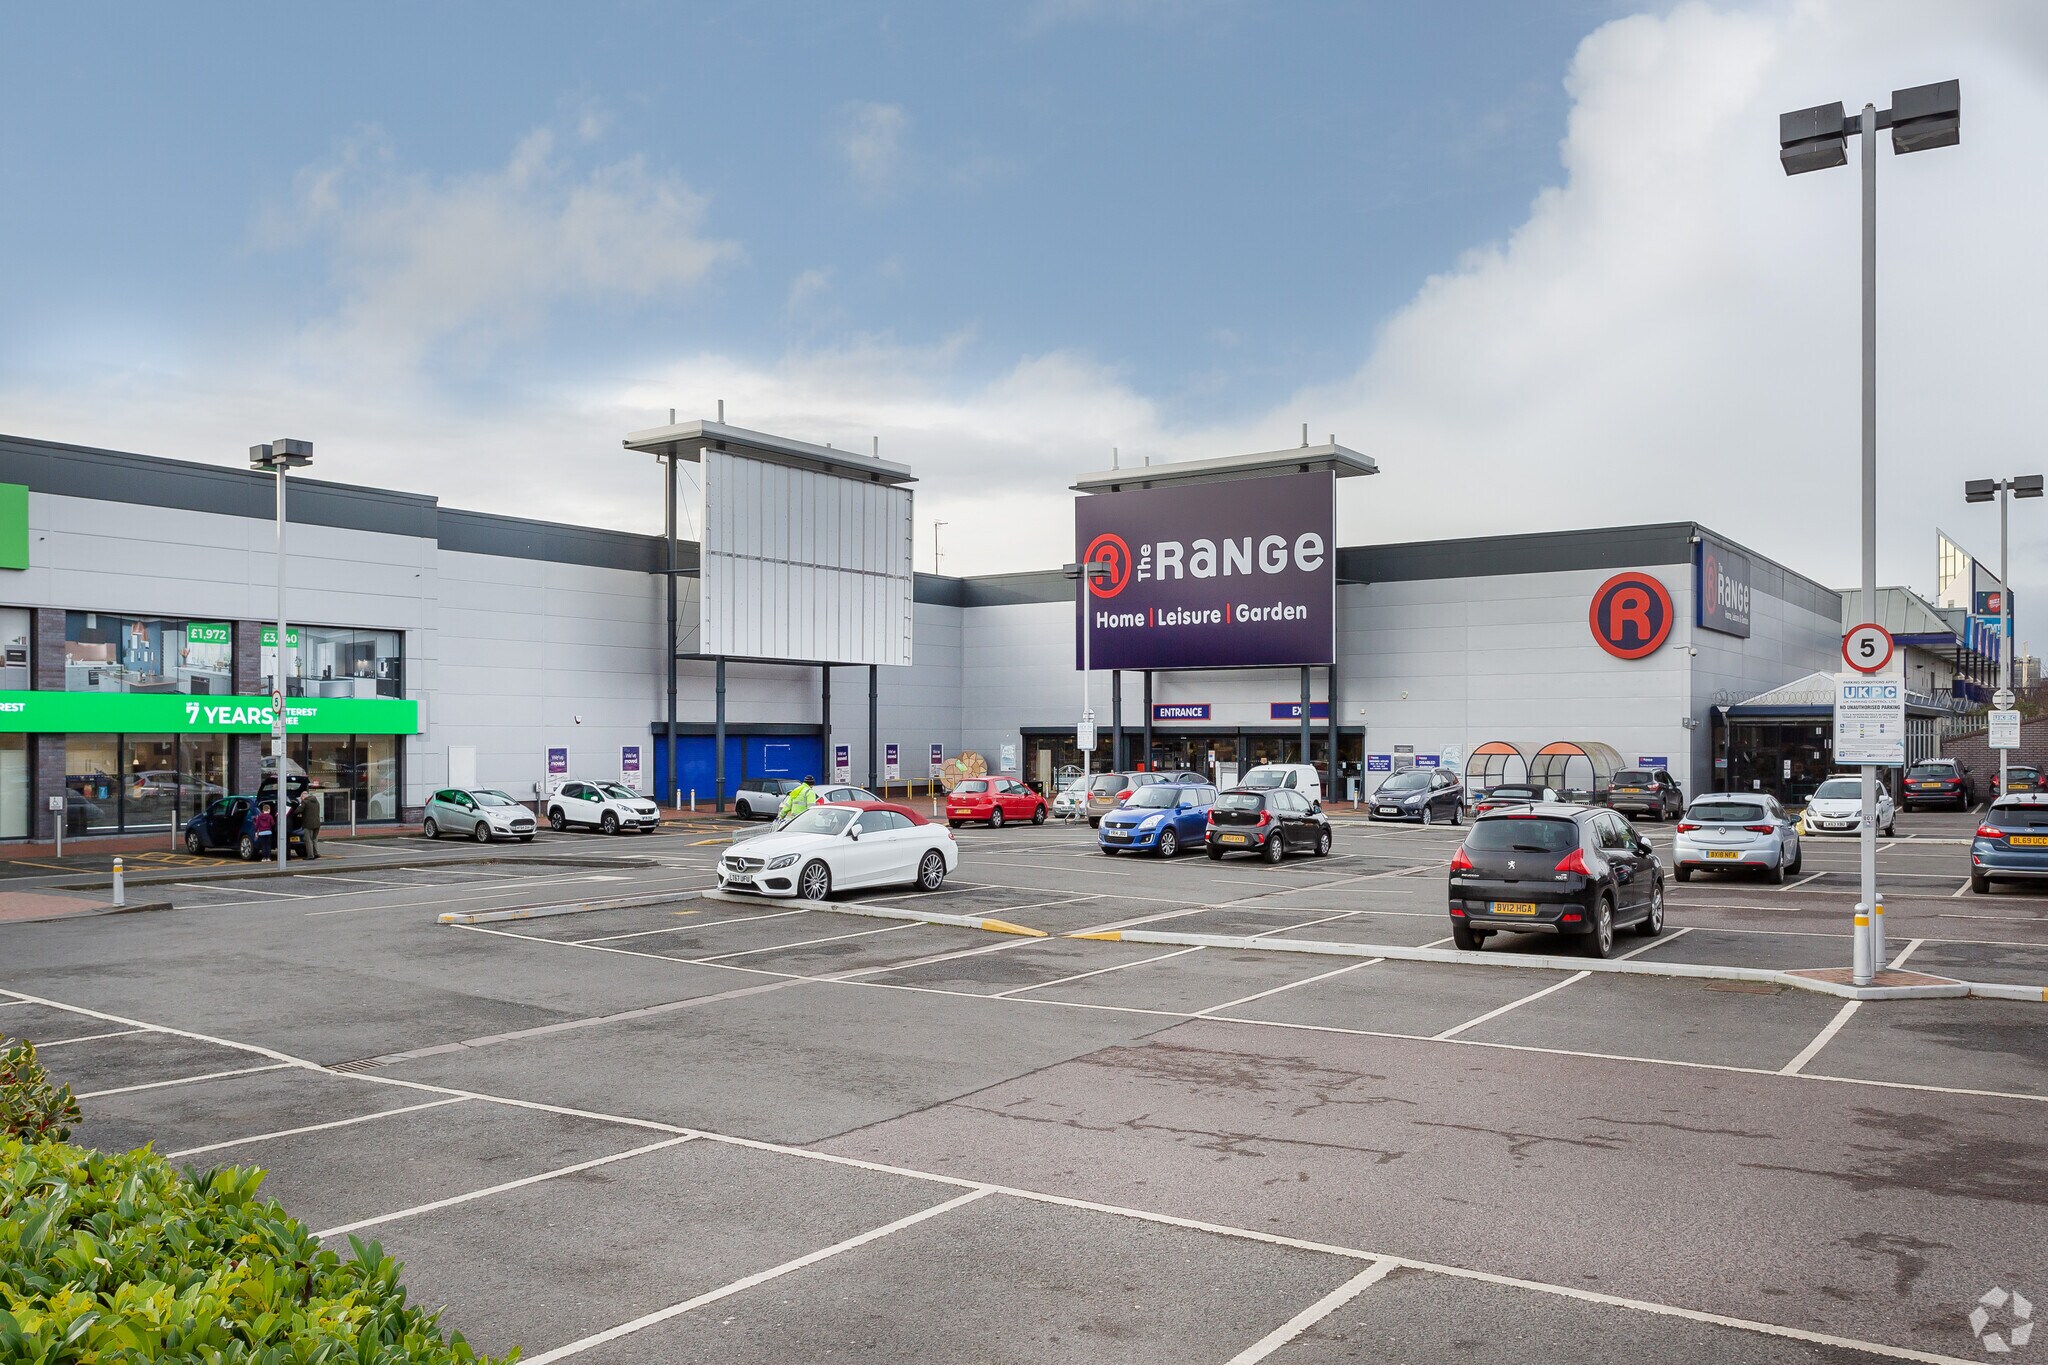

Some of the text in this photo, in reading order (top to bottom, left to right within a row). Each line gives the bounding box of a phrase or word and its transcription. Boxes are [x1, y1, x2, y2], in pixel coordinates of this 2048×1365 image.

[1137, 543, 1151, 582] The
[1096, 601, 1307, 628] Home Leisure Garden
[190, 628, 227, 640] £1,972
[263, 632, 298, 644] £3,40
[1860, 638, 1875, 658] 5
[1844, 686, 1897, 698] UKPC
[274, 697, 279, 708] 5
[185, 706, 274, 725] 7 YEARS
[1160, 707, 1203, 717] ENTRANCE
[1496, 903, 1533, 913] BV12 HGA
